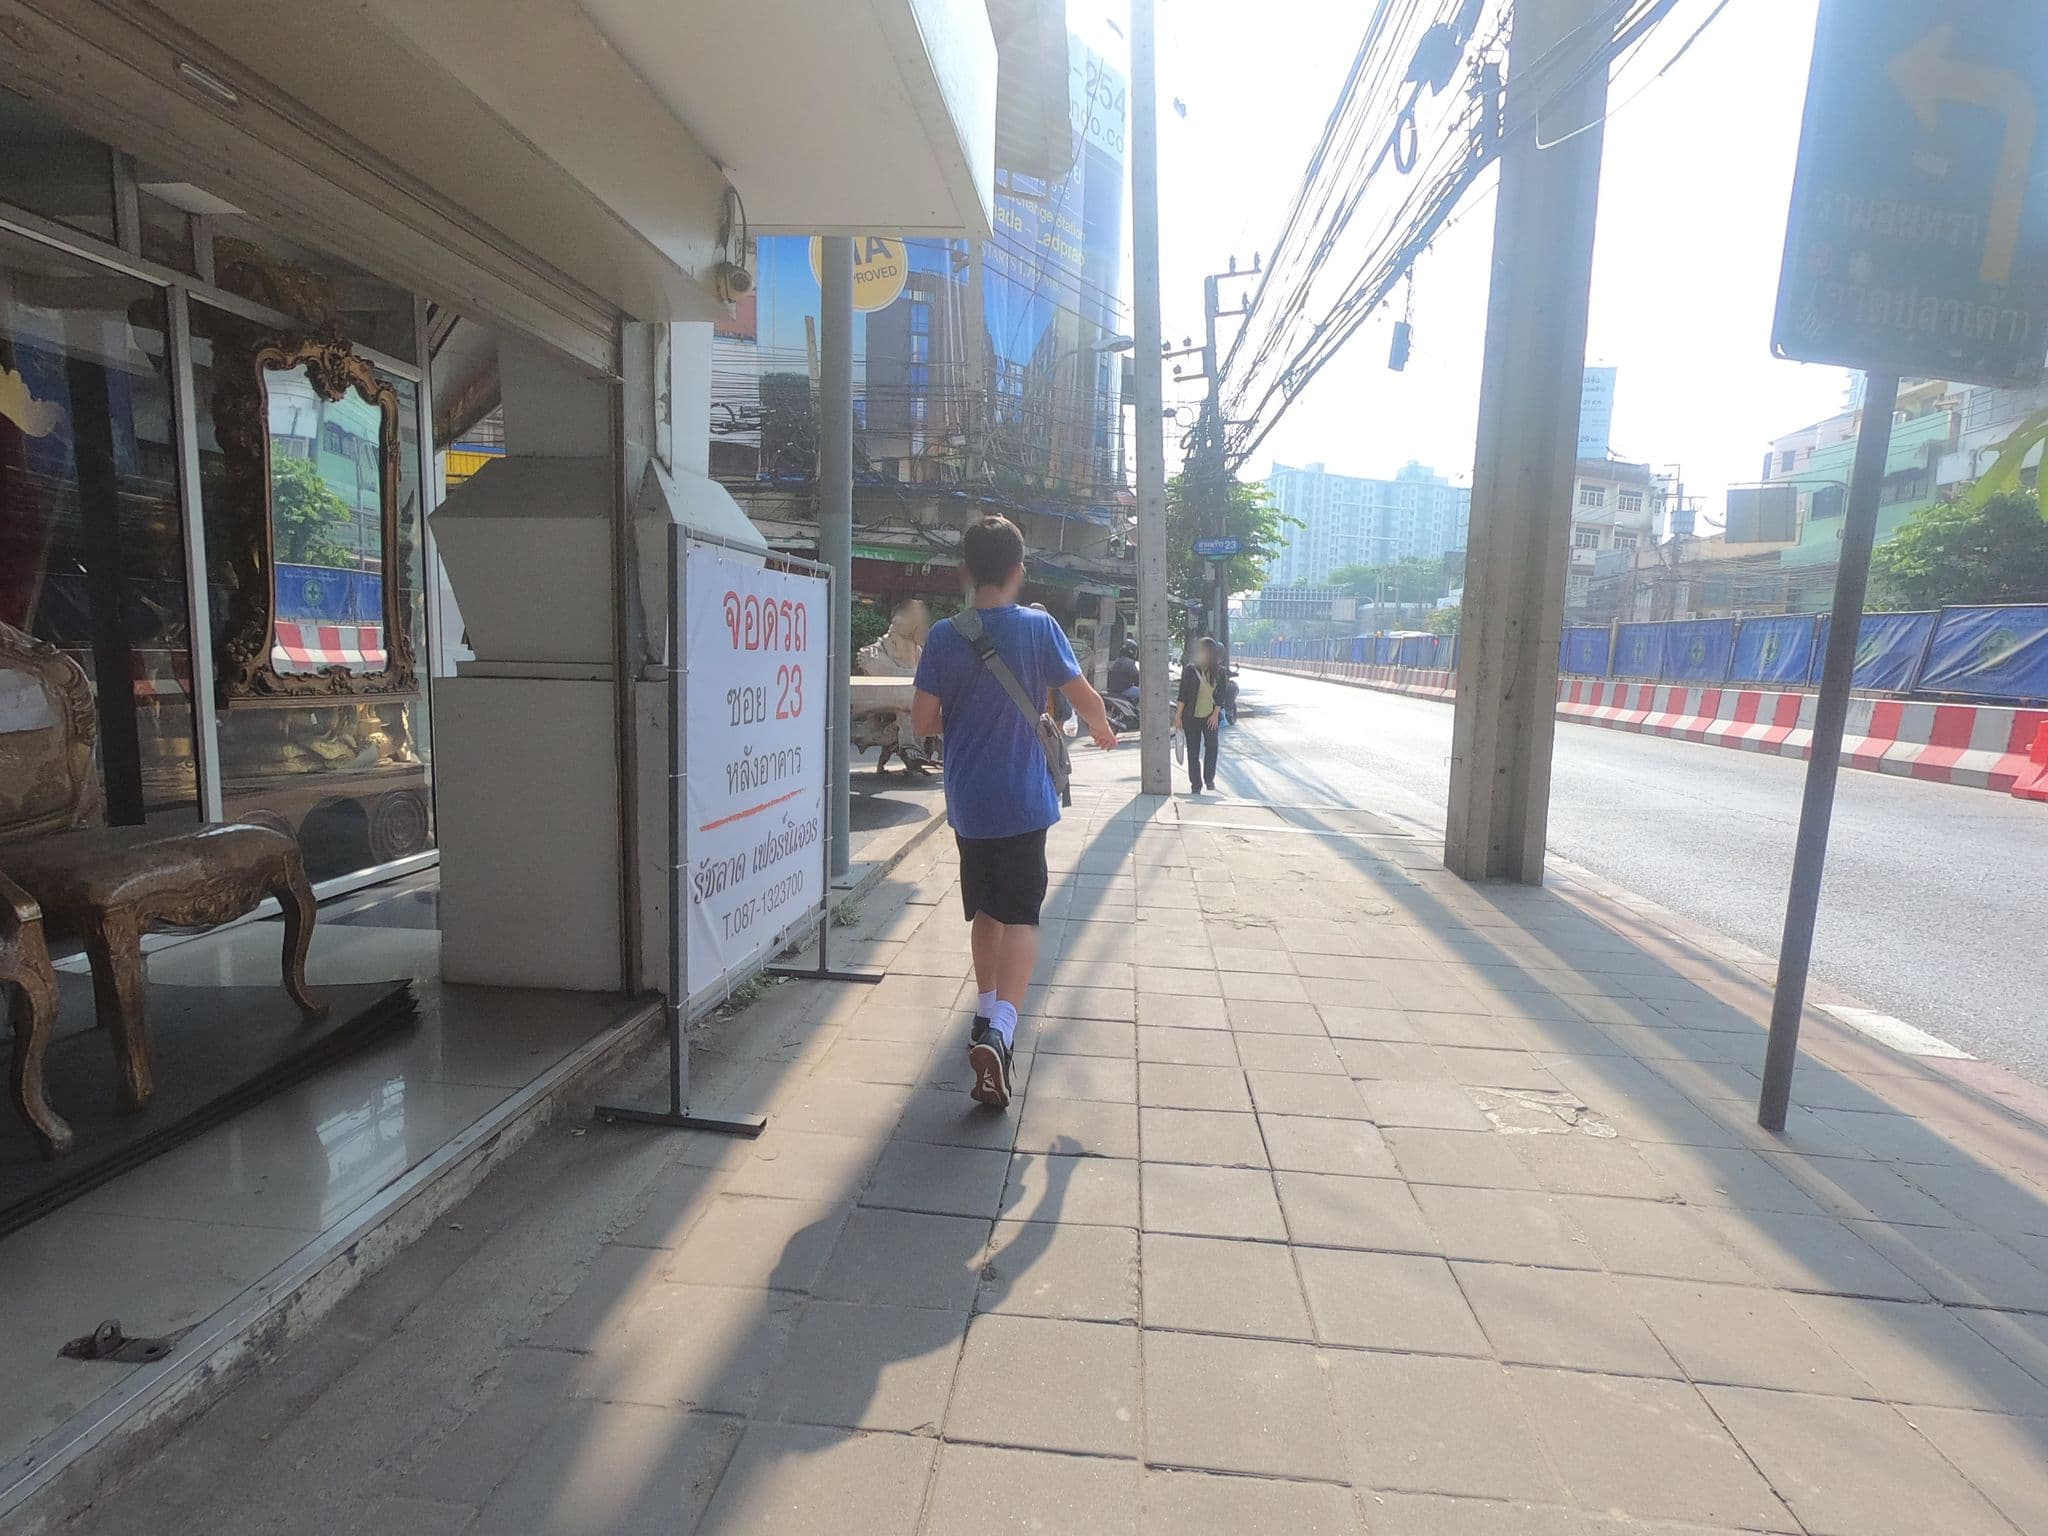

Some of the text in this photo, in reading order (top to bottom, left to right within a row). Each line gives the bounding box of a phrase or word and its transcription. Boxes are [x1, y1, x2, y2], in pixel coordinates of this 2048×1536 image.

[853, 265, 898, 284] ROVED
[1224, 540, 1237, 550] 23
[723, 591, 808, 652] จอดรถ
[726, 664, 803, 727] ซอย 23
[726, 745, 802, 796] หลังอาคาร
[694, 797, 821, 905] รัชลาด เฟอร์นิเจอร์
[722, 869, 804, 942] T.087-1323700
